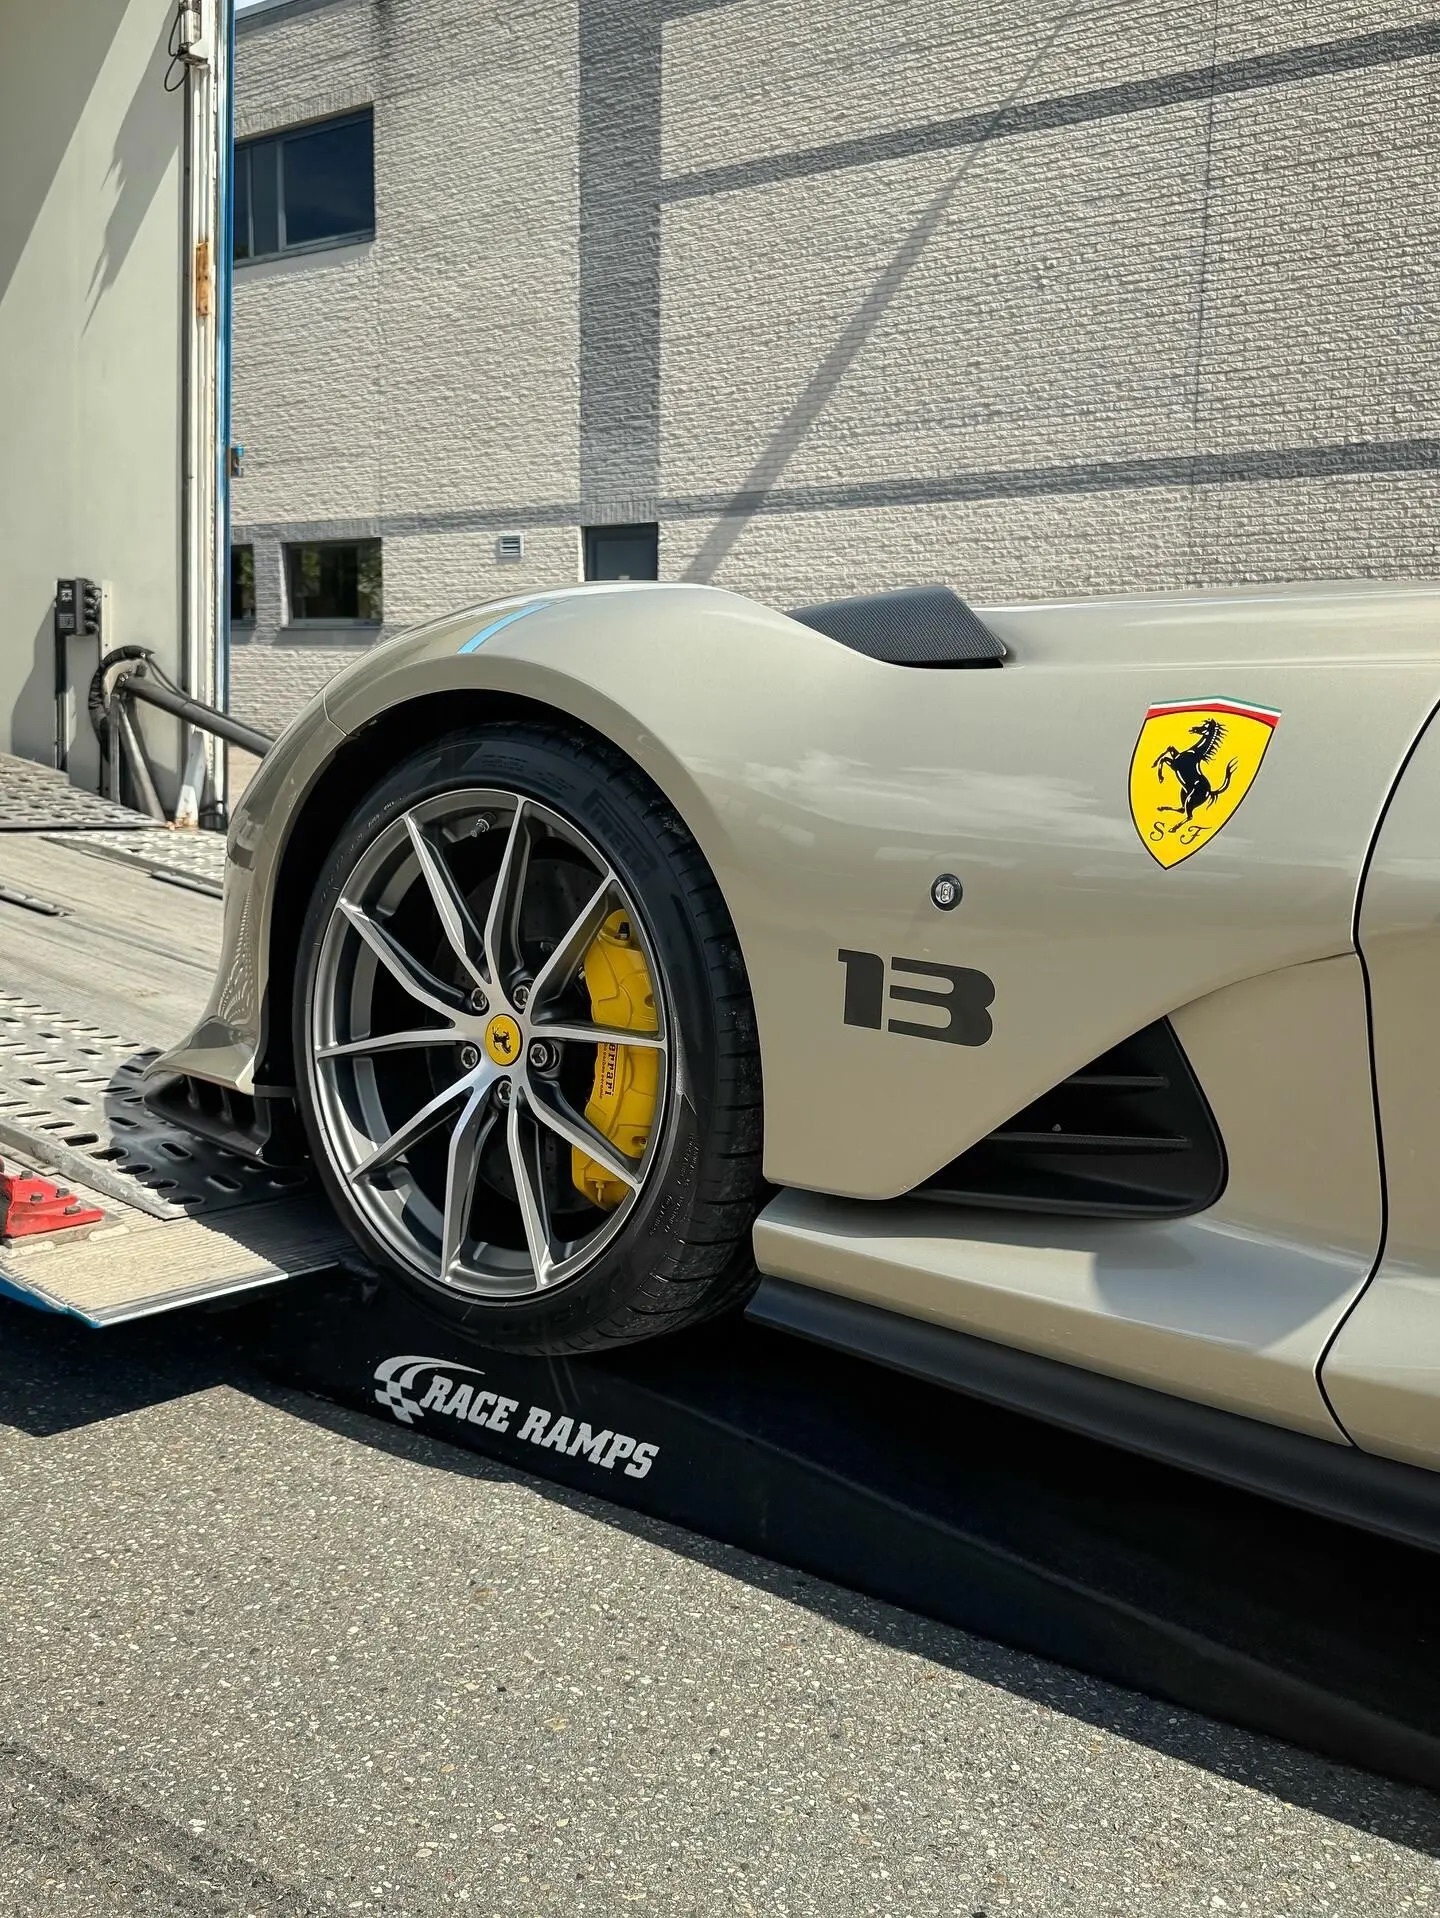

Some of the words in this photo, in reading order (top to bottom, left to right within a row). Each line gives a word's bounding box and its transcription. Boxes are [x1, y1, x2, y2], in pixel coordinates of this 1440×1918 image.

[1150, 821, 1165, 841] S
[1180, 825, 1212, 845] F
[838, 948, 996, 1047] 13
[604, 1043, 618, 1097] errari
[419, 1375, 519, 1433] RACE
[516, 1406, 660, 1478] RAMPS
